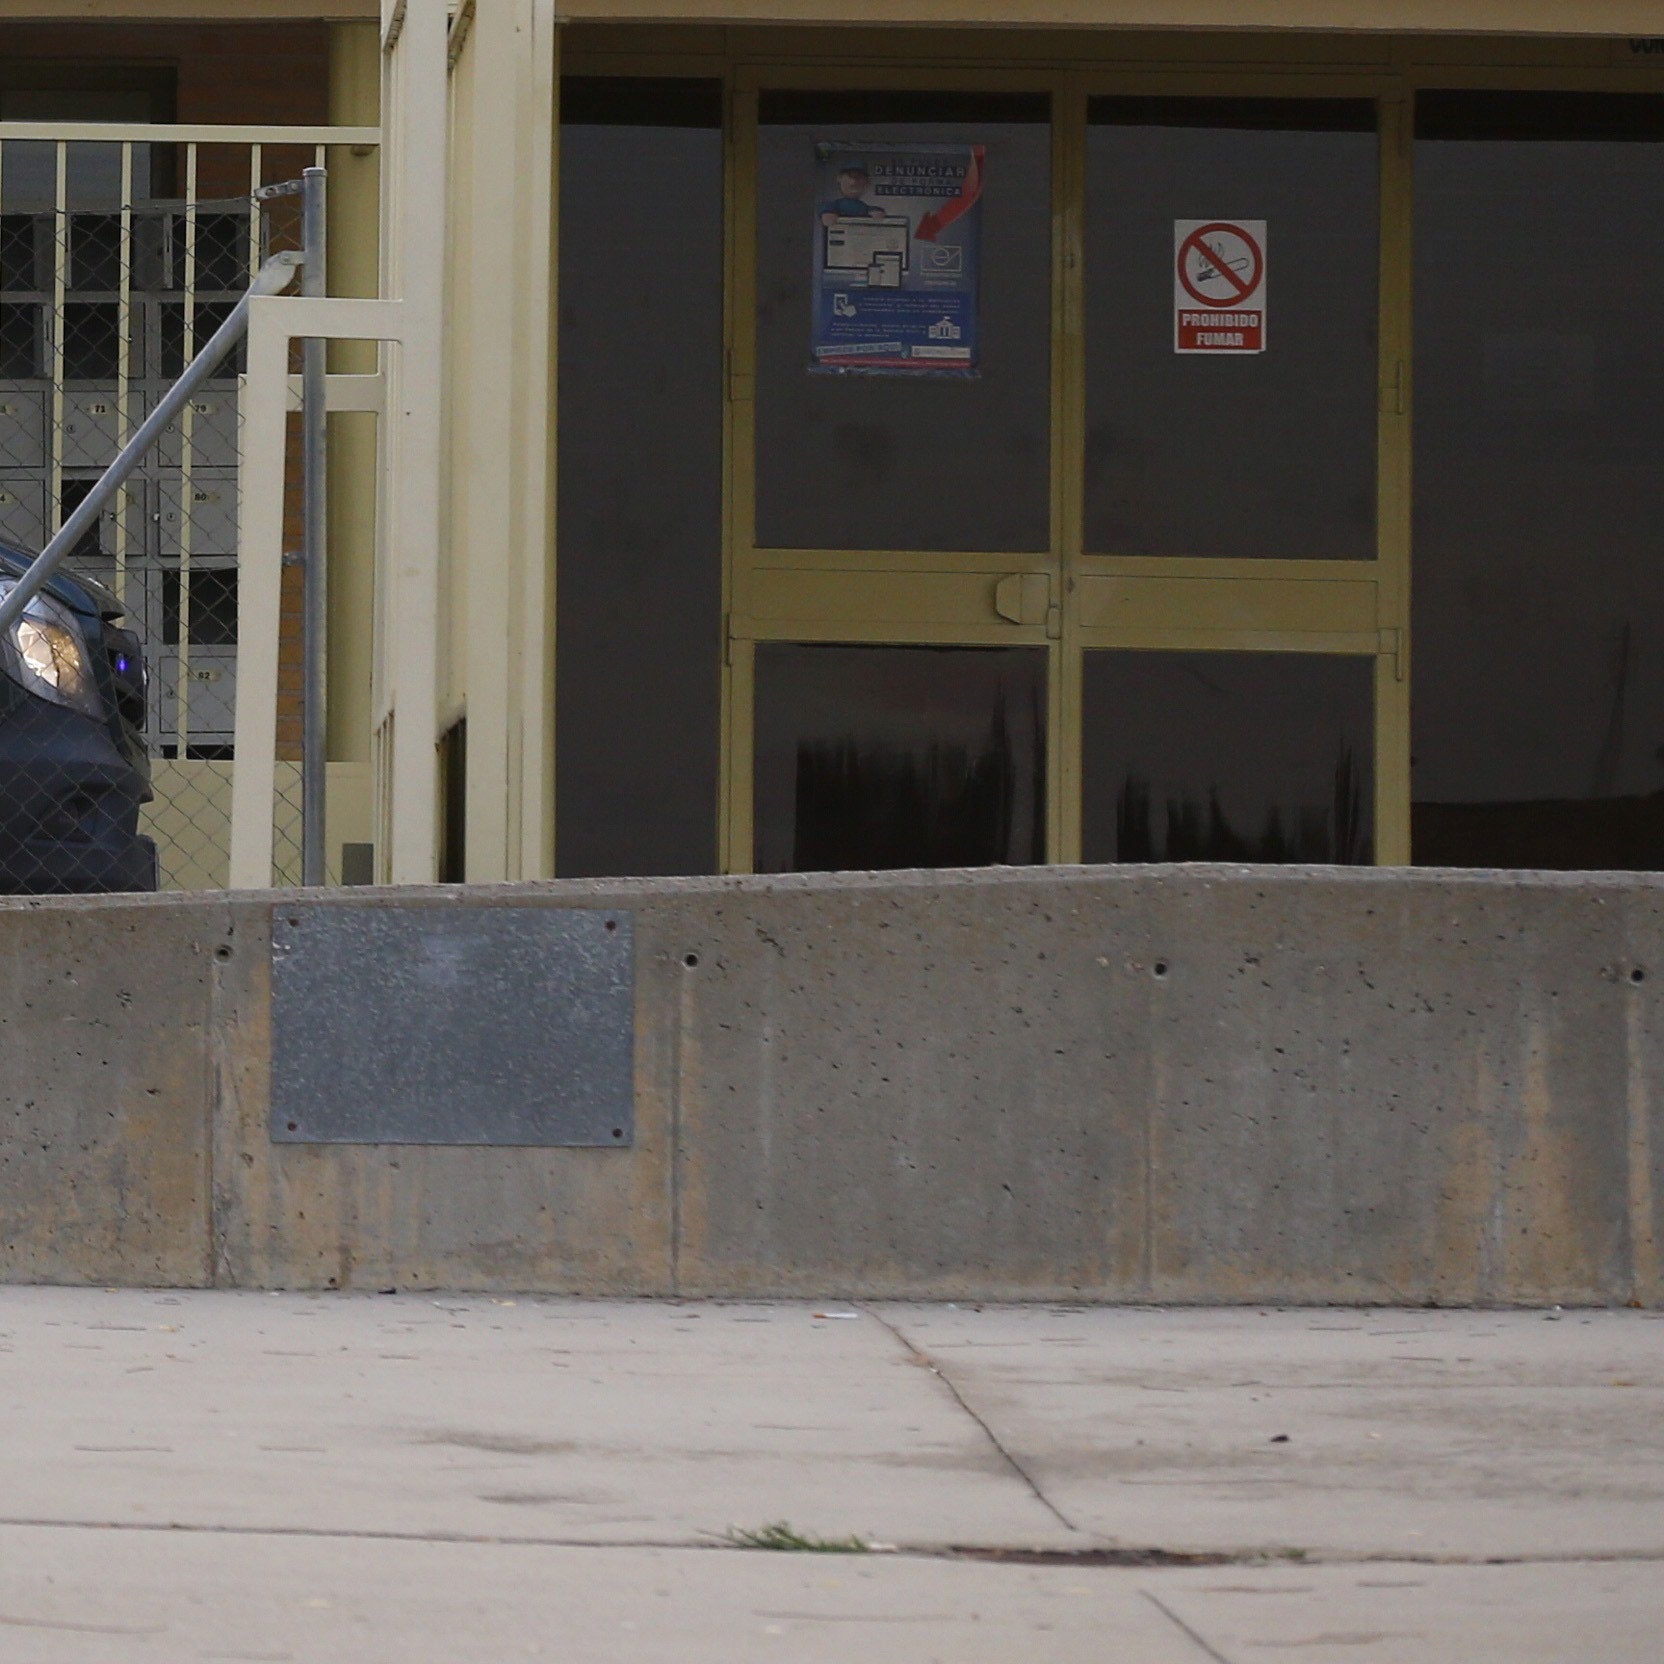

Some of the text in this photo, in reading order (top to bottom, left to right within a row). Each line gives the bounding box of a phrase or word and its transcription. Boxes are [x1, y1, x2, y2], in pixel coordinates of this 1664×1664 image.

[874, 165, 965, 177] DENUNCIAR
[1182, 313, 1259, 327] PROHIBIDO
[1195, 332, 1244, 346] FUMAR
